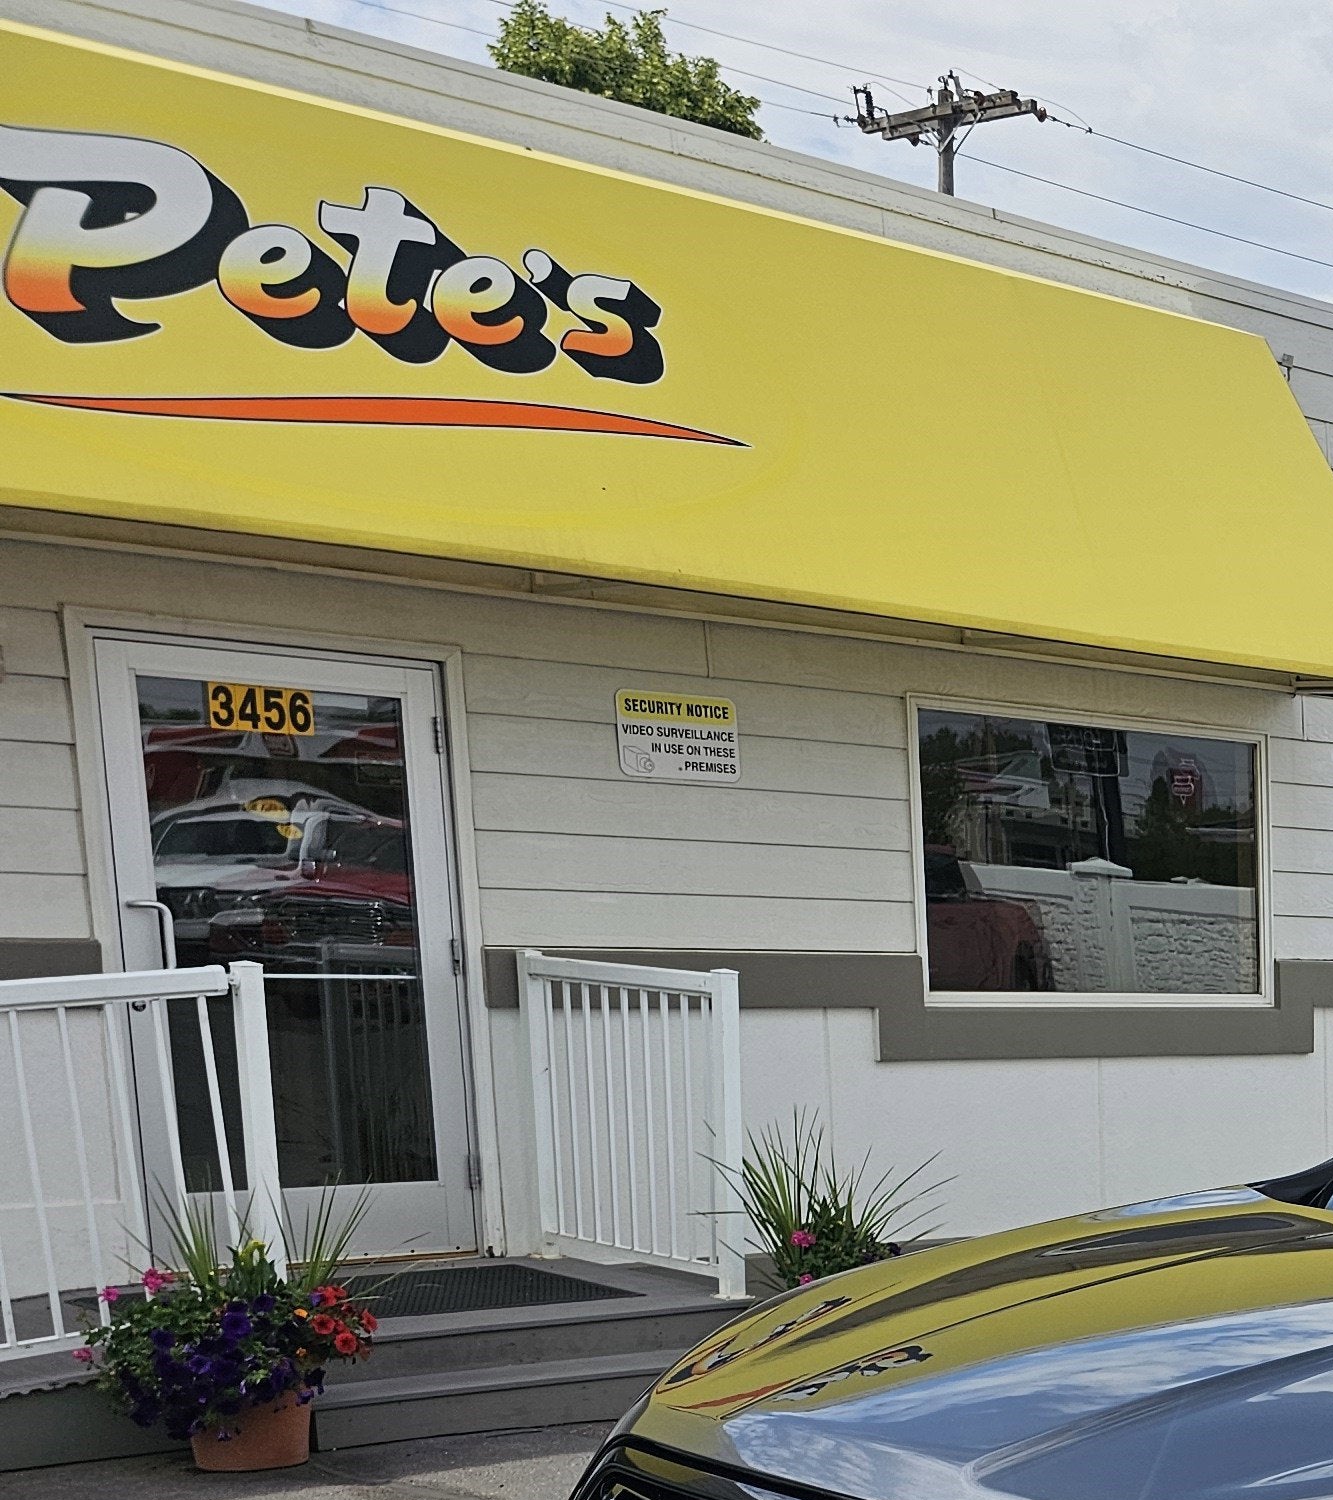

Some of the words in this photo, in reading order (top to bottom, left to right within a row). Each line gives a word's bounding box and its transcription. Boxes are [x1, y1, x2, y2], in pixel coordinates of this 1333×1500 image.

[0, 126, 664, 384] Pete's
[211, 686, 311, 733] 3456
[624, 698, 682, 715] SECURITY
[686, 704, 729, 720] NOTICE
[622, 724, 654, 736] VIDEO
[656, 727, 735, 743] SURVEILLANCE
[651, 743, 661, 753] IN
[664, 744, 684, 755] USE
[686, 745, 700, 756] ON
[703, 746, 736, 758] THESE
[684, 761, 737, 774] PREMISES
